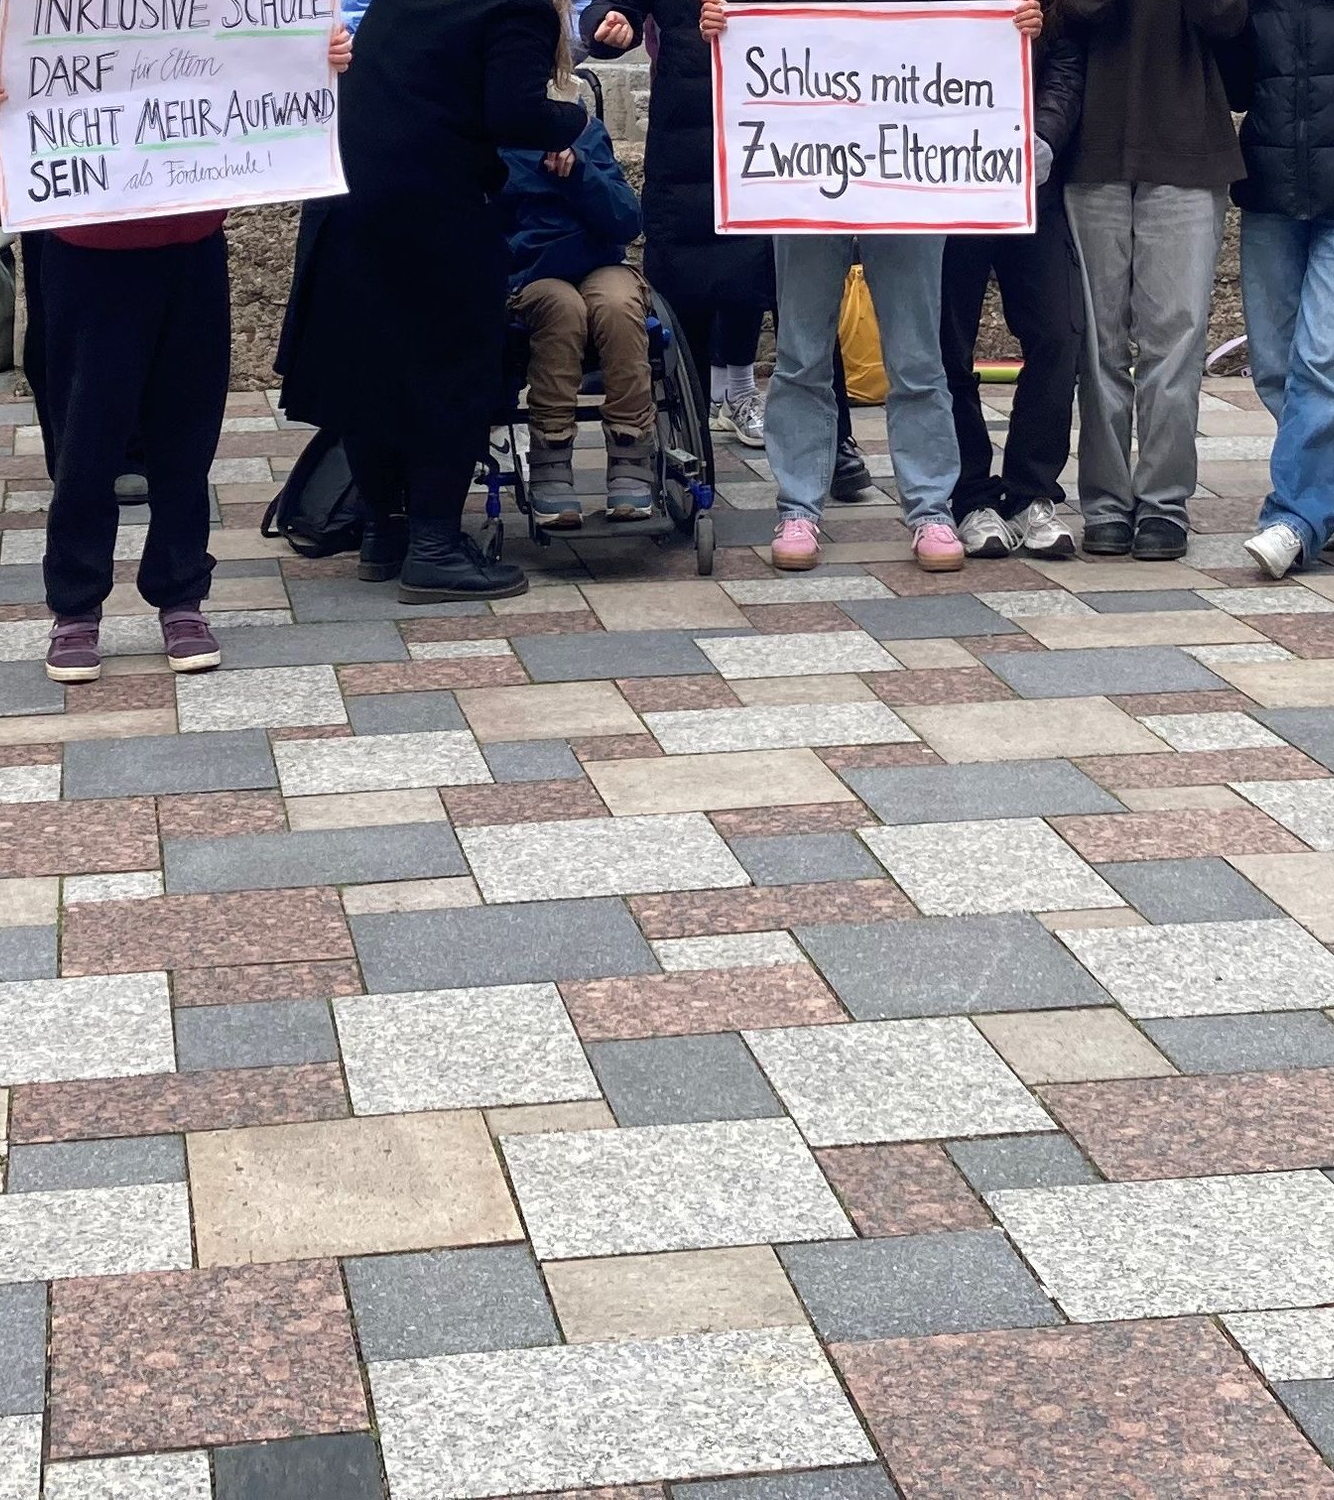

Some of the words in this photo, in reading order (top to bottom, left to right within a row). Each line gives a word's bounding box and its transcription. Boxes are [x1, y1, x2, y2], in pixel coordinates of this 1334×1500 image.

[28, 49, 120, 99] DARF
[129, 52, 157, 92] für
[159, 42, 223, 84] Eltern
[744, 46, 862, 104] Schluss
[871, 63, 920, 105] mit
[922, 62, 995, 108] dem
[27, 105, 125, 156] NICHT
[135, 97, 222, 146] MEHR
[221, 89, 336, 138] AUFWAND
[28, 155, 110, 203] SEIN
[123, 158, 154, 192] als
[738, 120, 1023, 200] Zwangs-Elterntaxi
